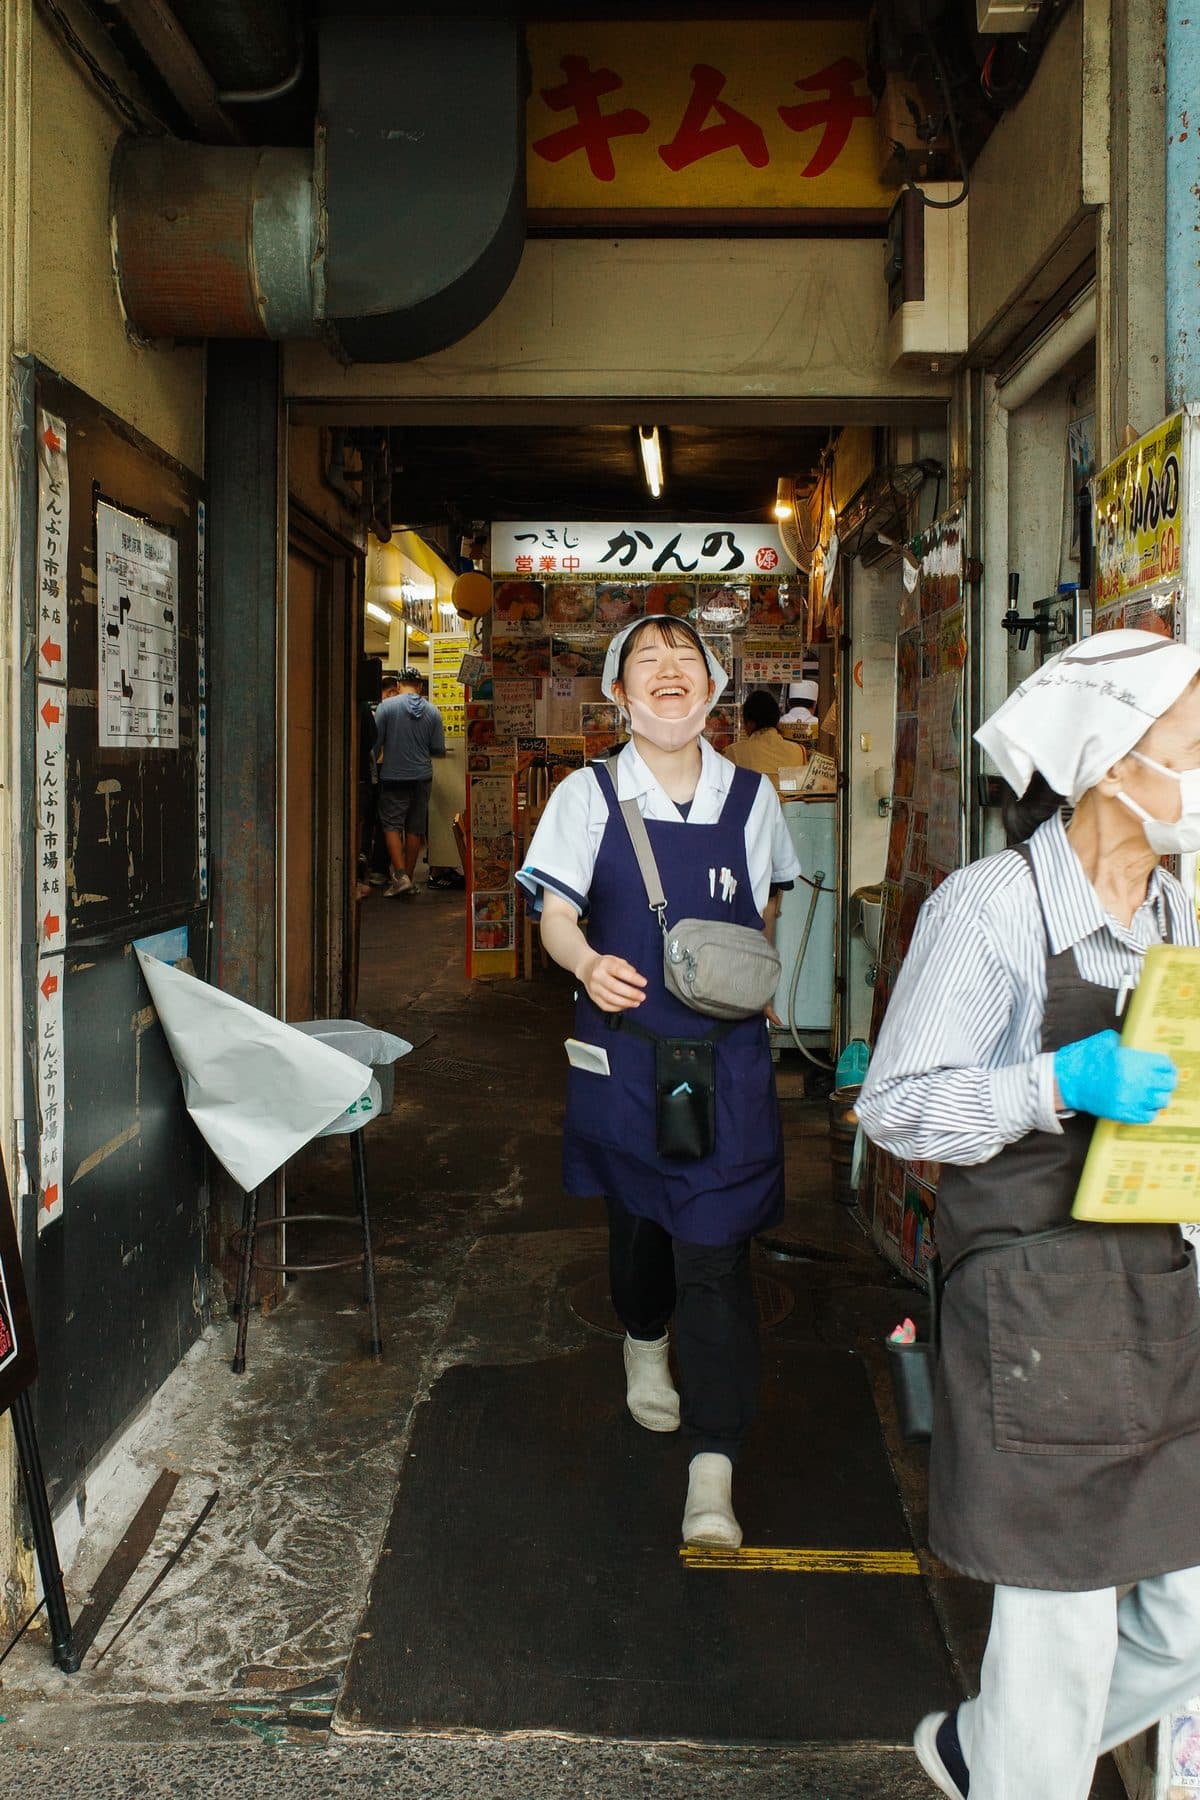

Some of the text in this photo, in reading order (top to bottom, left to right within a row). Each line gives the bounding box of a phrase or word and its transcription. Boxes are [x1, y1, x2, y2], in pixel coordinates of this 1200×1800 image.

[533, 55, 875, 182] キムチ
[41, 480, 63, 625] どんぶり市場 本店
[513, 527, 580, 549] つきじ
[515, 555, 580, 573] 営業中
[596, 529, 745, 572] かんの
[1160, 527, 1174, 575] 60
[42, 749, 60, 895] どんぶり市場 本店
[43, 1019, 58, 1142] どんぶり市場
